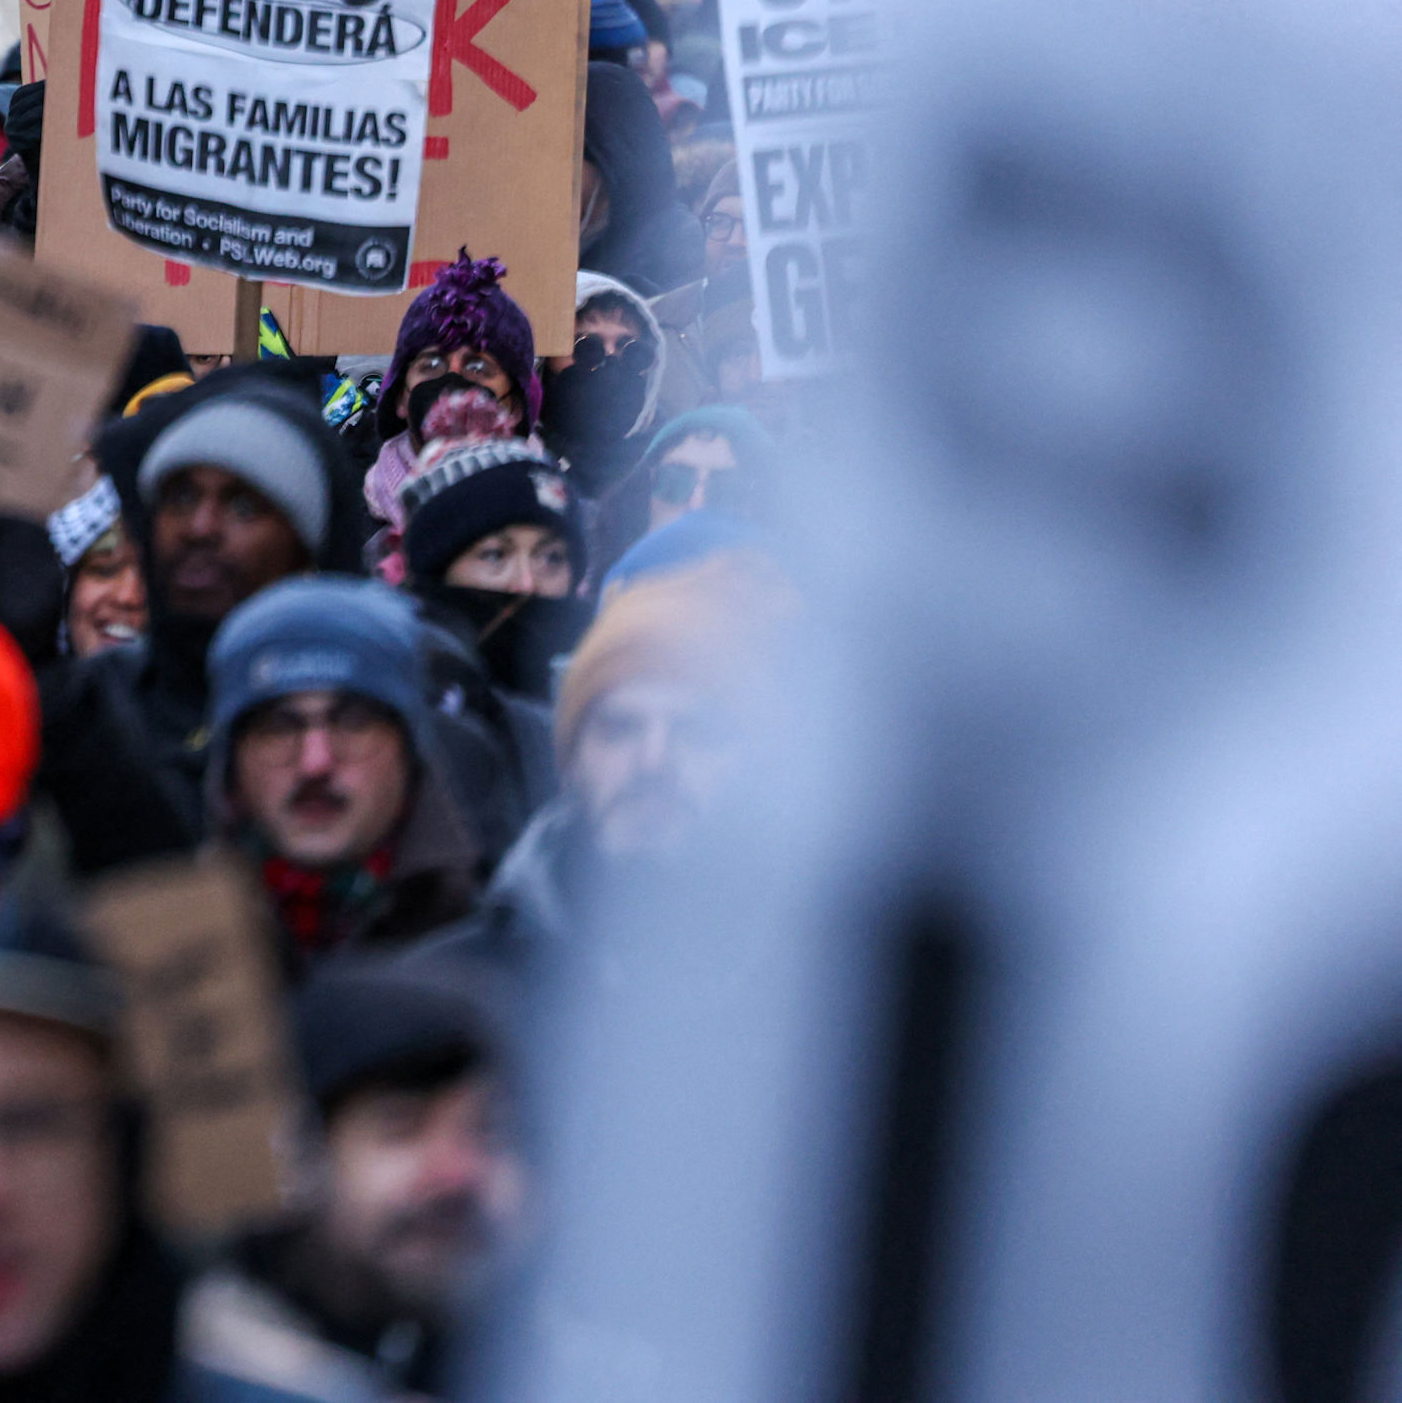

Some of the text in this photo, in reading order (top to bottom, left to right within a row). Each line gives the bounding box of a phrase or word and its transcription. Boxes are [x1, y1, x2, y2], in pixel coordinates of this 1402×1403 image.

[110, 69, 407, 150] A LAS FAMILIAS
[110, 112, 402, 202] MIGRANTES!
[110, 185, 314, 248] Party for Socialism and
[113, 209, 193, 248] Liberation
[219, 236, 338, 279] PSLWeb.org
